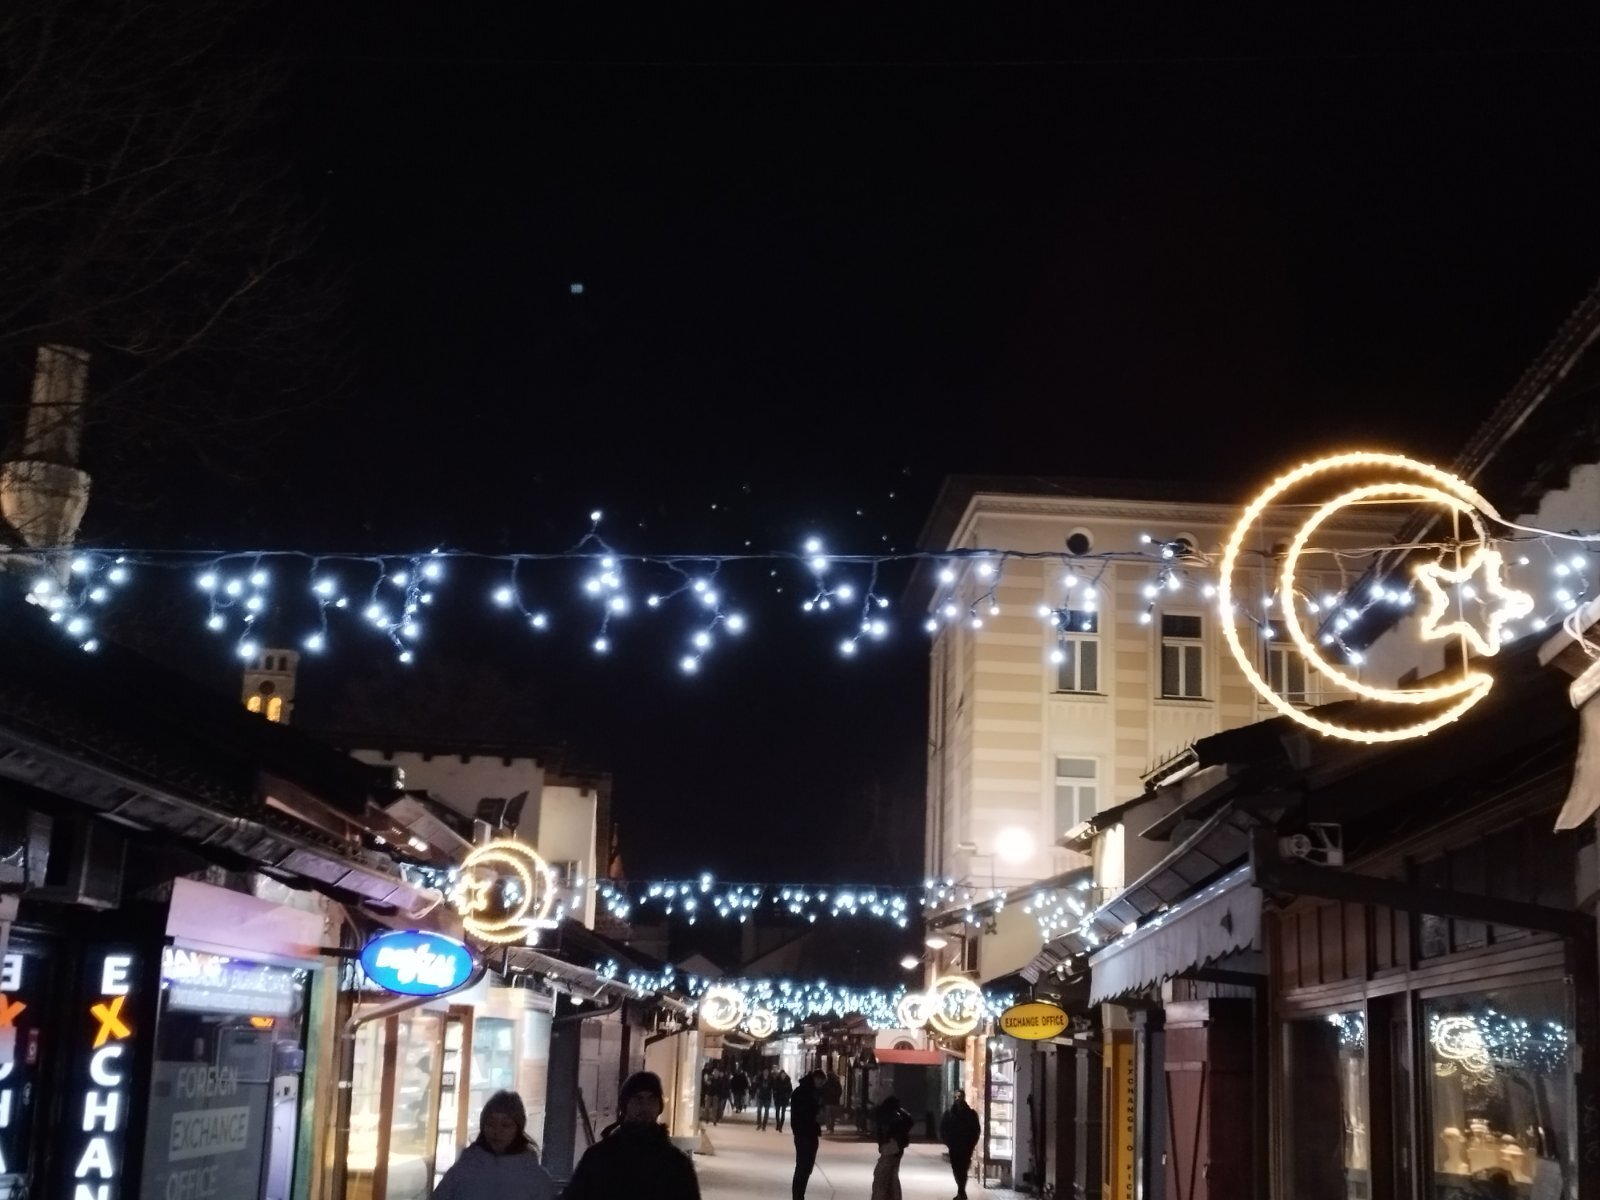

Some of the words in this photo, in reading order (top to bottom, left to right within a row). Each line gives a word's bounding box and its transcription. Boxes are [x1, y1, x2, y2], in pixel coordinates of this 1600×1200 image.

[1005, 1016, 1039, 1028] EXCHANGE
[1041, 1015, 1064, 1026] OFFICE
[176, 1066, 239, 1099] FOREIGN
[172, 1113, 247, 1151] EXCHANGE
[166, 1164, 219, 1200] OFFICE
